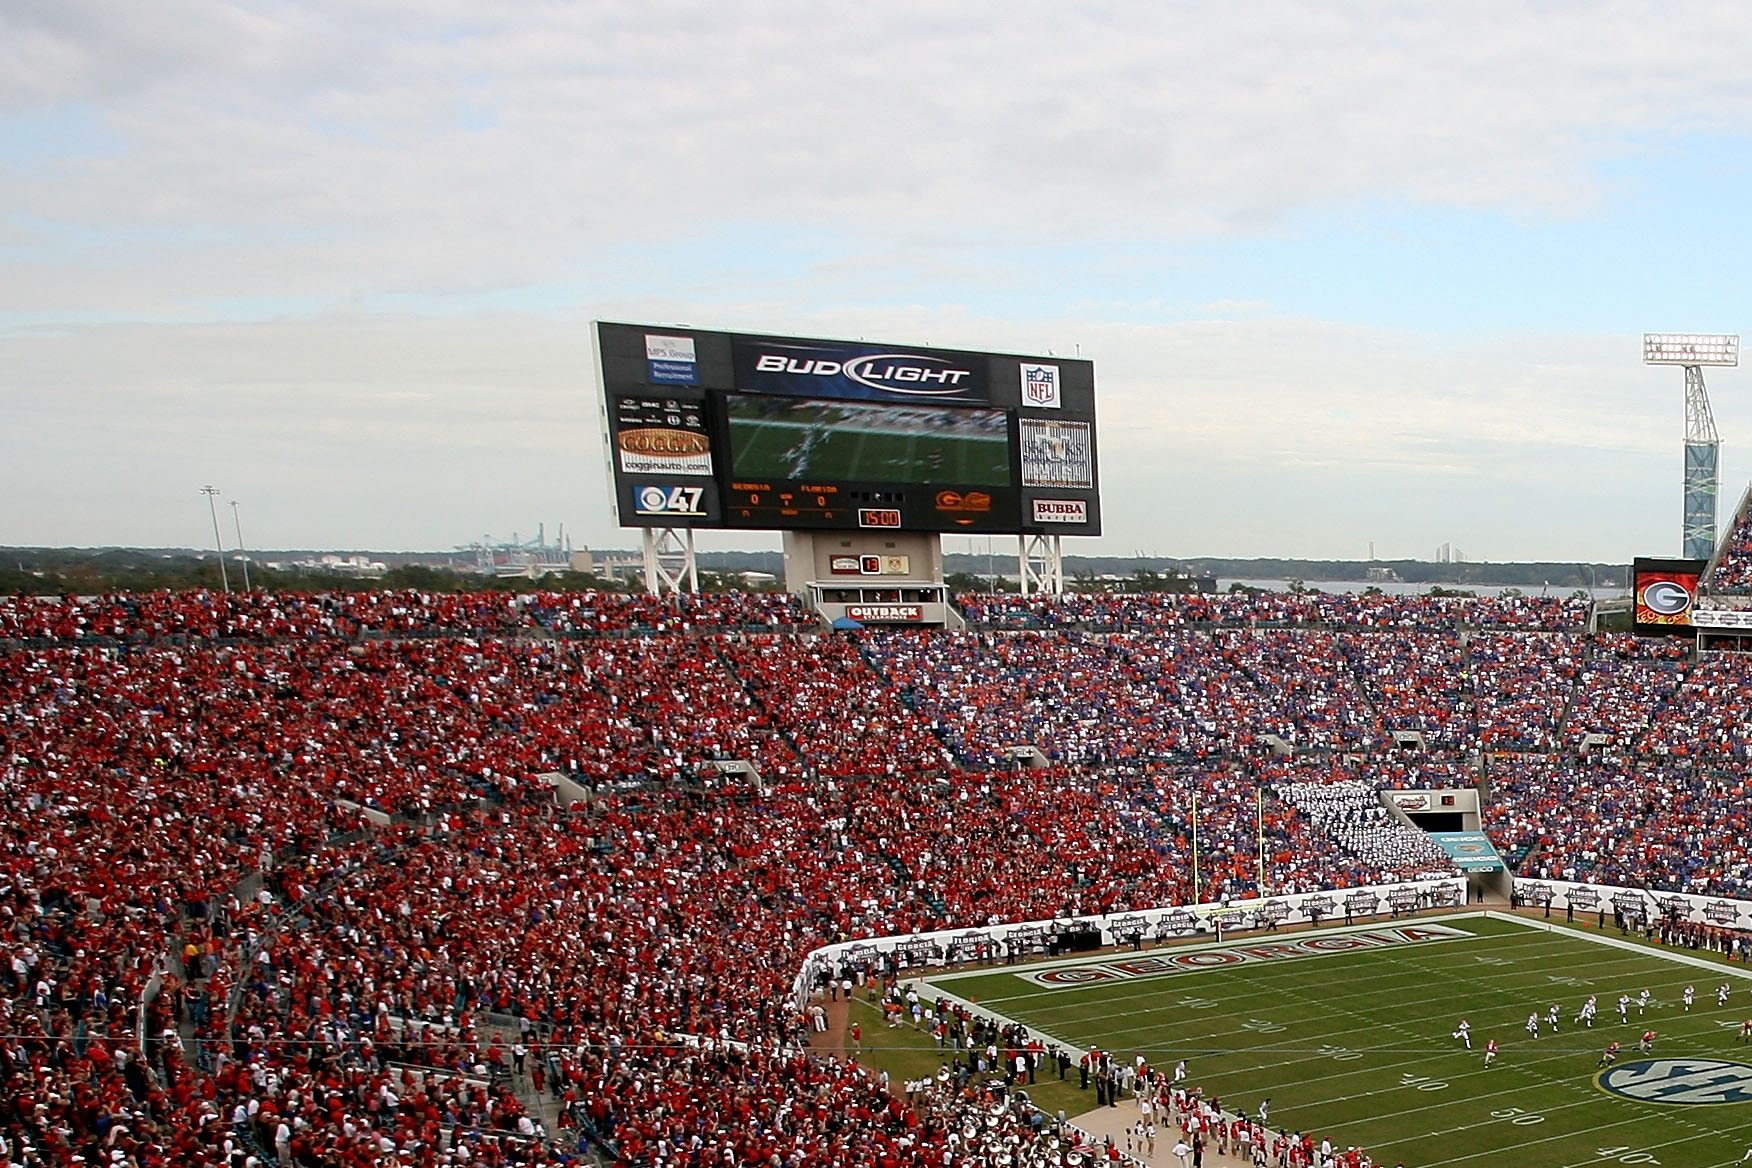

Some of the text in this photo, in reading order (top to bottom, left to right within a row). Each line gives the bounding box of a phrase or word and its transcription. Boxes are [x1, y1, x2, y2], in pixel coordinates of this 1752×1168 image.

[669, 349, 695, 360] Group
[756, 355, 970, 385] BUD LIGHT
[1030, 382, 1052, 400] NFL
[622, 435, 706, 452] COGGIN
[625, 460, 709, 472] cogginauto.com
[668, 487, 704, 513] 47
[1037, 503, 1083, 514] BUBBA
[864, 511, 899, 526] 15:00
[866, 559, 878, 571] 13
[851, 607, 918, 617] OUTBACK
[1569, 889, 1598, 898] FLORIDA
[1615, 892, 1644, 902] GEORGIA
[1569, 897, 1598, 906] GEORGIA
[1708, 904, 1735, 912] GEORGIA
[1708, 912, 1735, 921] FLORIDA
[1113, 918, 1145, 928] GEORGIA
[954, 933, 990, 945] FLORIDA
[1008, 928, 1043, 939] GEORGIA
[897, 940, 933, 951] GEORGIA
[1035, 927, 1454, 985] GEORGIA
[1400, 1074, 1450, 1091] 40
[1490, 1107, 1545, 1126] 50
[1595, 1146, 1654, 1165] 40
